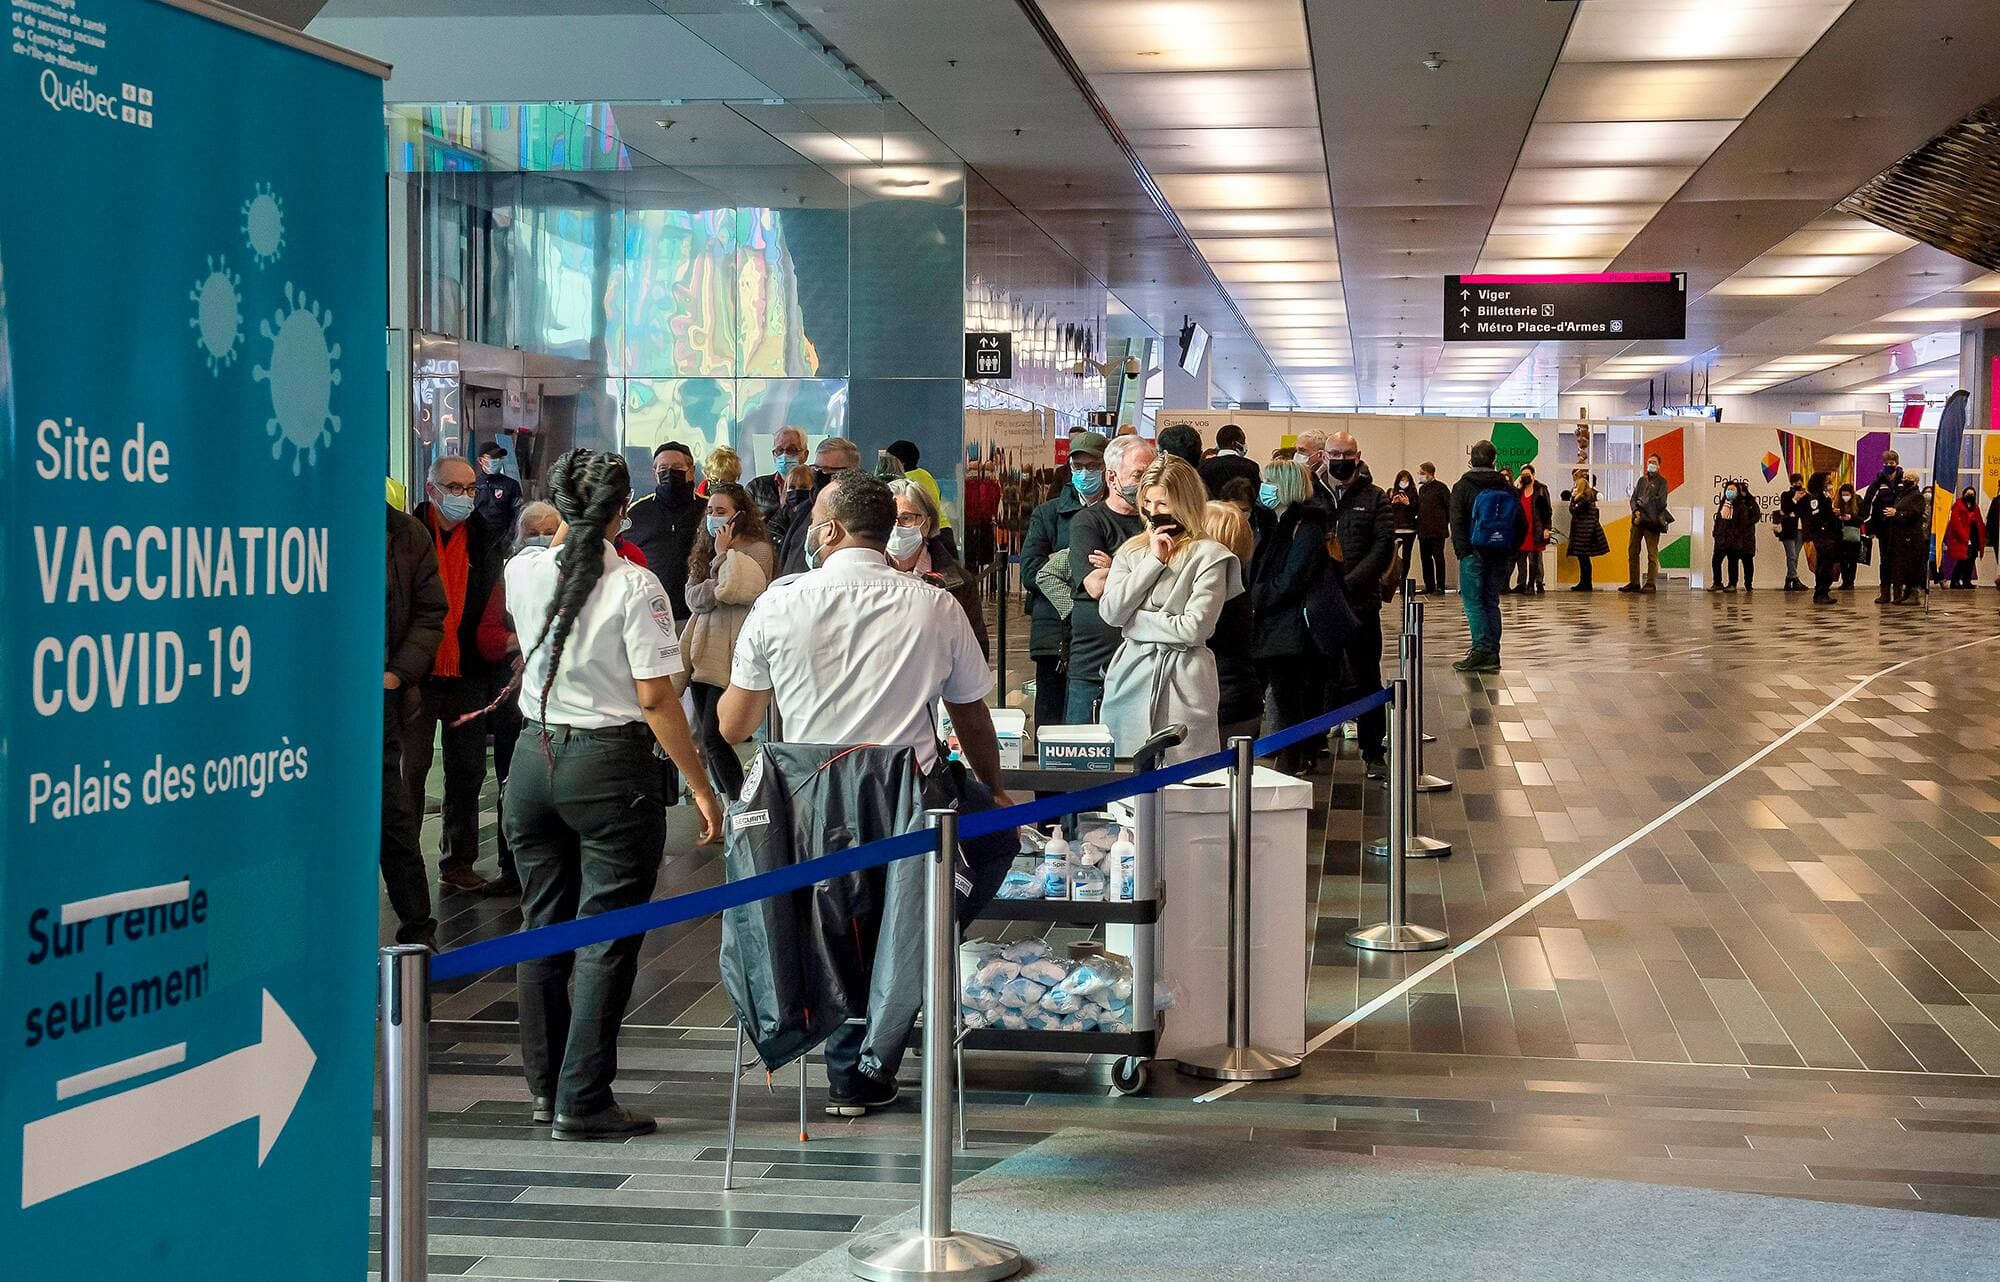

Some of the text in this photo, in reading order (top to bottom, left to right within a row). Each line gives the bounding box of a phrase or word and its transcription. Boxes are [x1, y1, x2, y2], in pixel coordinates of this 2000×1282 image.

[40, 68, 118, 119] Québec
[1478, 289, 1511, 302] Viger
[1674, 273, 1685, 292] 1
[1477, 305, 1538, 316] Billetterie
[1477, 321, 1606, 333] Métro Place-d'Armes
[480, 399, 502, 408] AP6
[35, 417, 170, 484] Site de
[33, 525, 329, 604] VACCINATION
[32, 624, 252, 718] COVID-19
[1045, 746, 1105, 758] HUMASK
[28, 735, 309, 824] Palais des congrès
[27, 907, 92, 966] Sur
